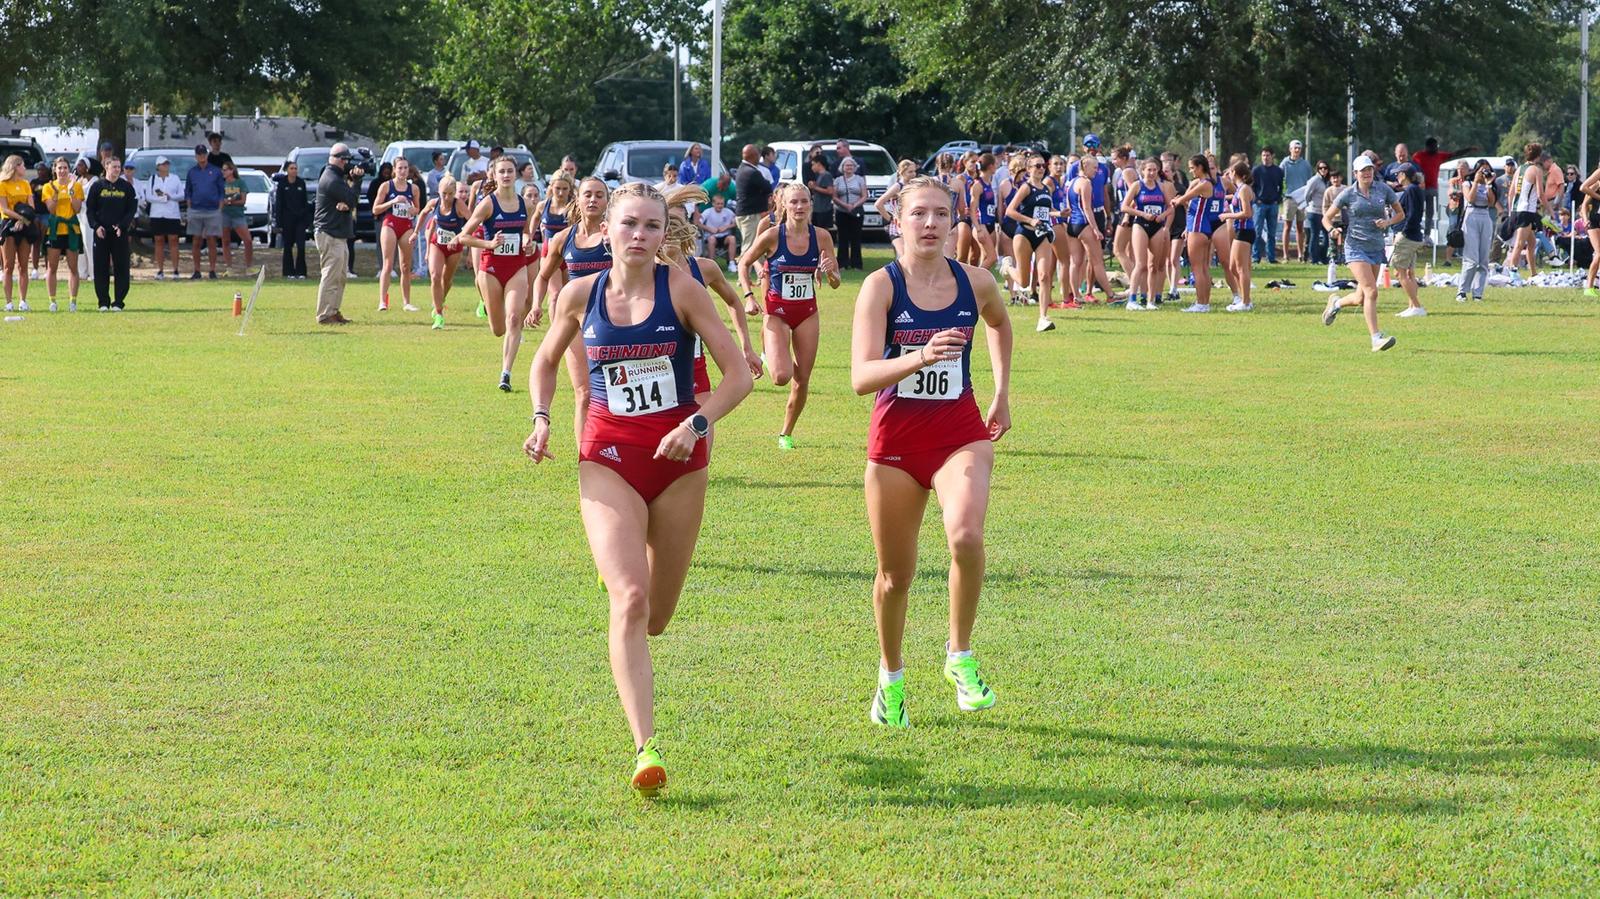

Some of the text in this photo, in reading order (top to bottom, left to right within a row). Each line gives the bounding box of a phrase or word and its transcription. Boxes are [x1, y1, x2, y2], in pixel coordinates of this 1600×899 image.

[500, 243, 515, 254] 304
[790, 285, 807, 298] 307
[586, 341, 678, 361] RICHMOND
[628, 364, 668, 377] RUNNING
[913, 370, 949, 395] 306
[622, 380, 663, 413] 314
